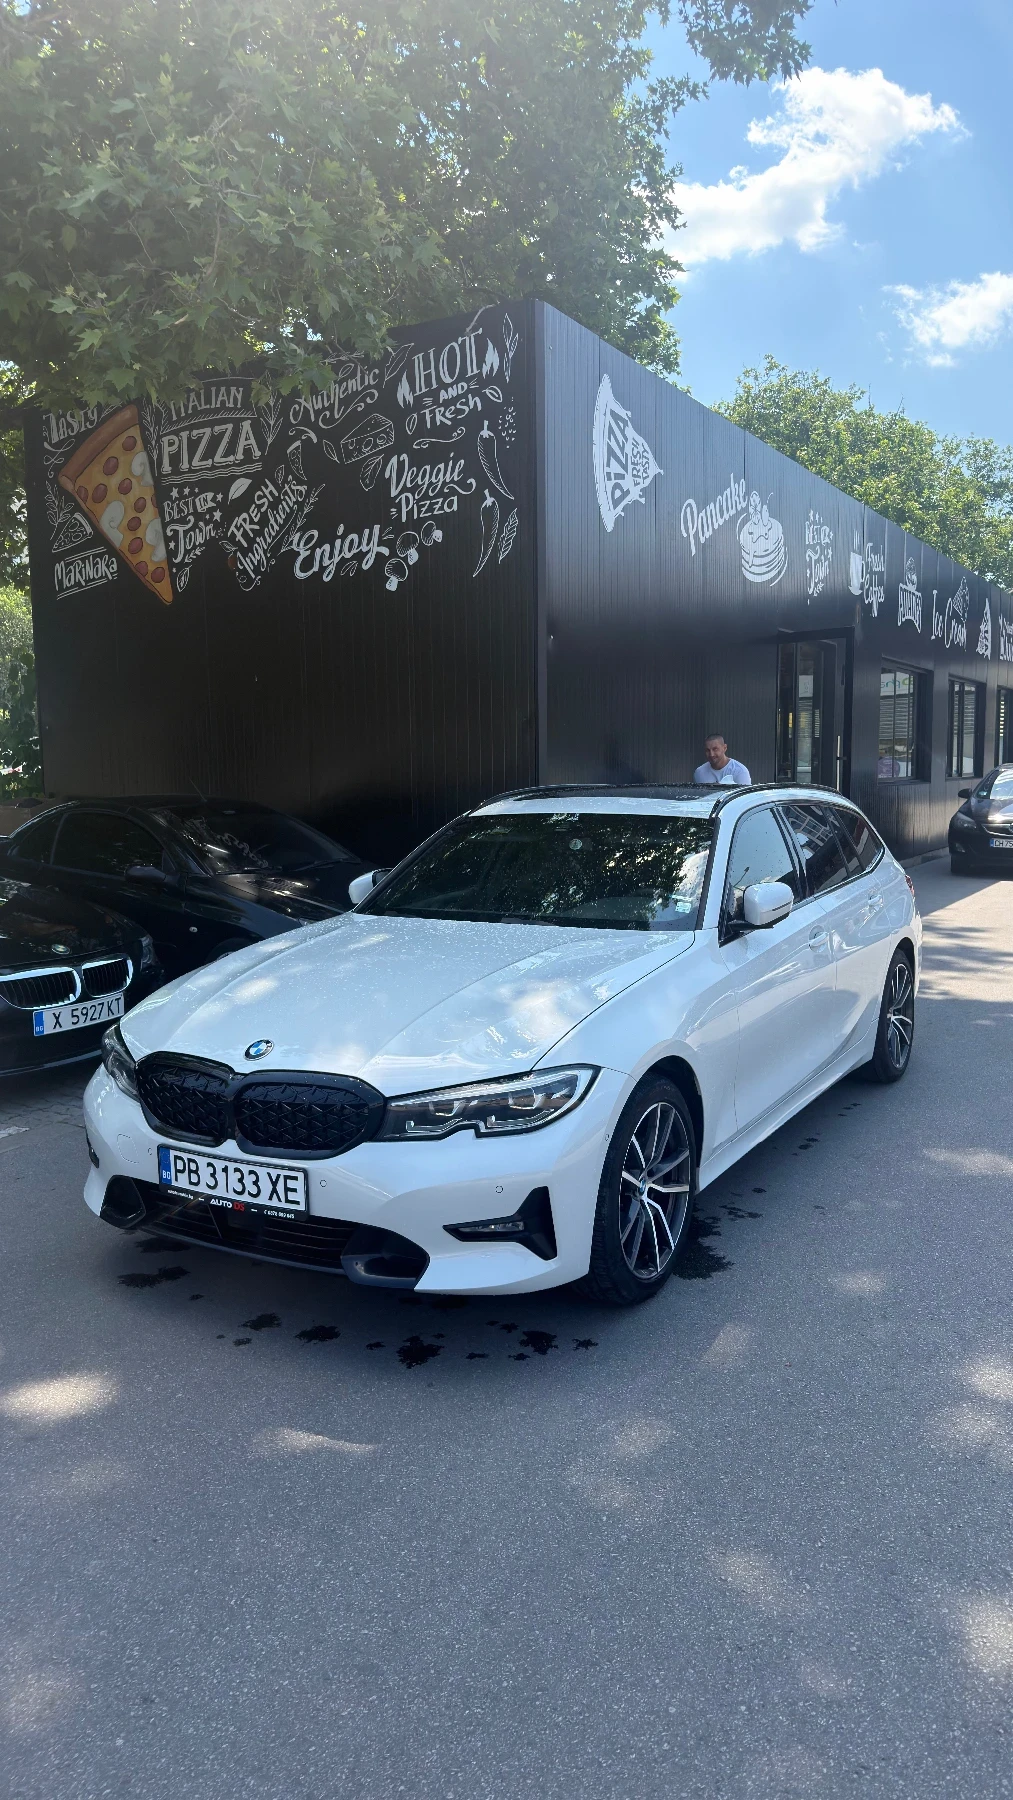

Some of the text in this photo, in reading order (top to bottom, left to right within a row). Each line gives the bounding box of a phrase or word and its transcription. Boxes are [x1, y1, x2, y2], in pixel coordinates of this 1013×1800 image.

[412, 328, 482, 397] HOT
[171, 386, 243, 421] ITALIAN
[290, 364, 379, 424] Authentic
[439, 382, 468, 403] AND
[160, 419, 262, 475] PIZZA
[641, 442, 650, 485] TASTY
[385, 452, 466, 498] Veggie
[163, 496, 194, 522] BEST
[228, 478, 278, 548] FRESH
[237, 475, 307, 579] Ingredients
[395, 492, 459, 522] Pizza
[681, 472, 747, 557] Pancake
[166, 515, 216, 564] Town
[292, 524, 389, 582] Enjoy
[930, 590, 943, 640] Ice
[944, 597, 967, 652] Cream
[52, 997, 122, 1030] X 5927 KT
[173, 1154, 301, 1206] PB 3133 XE
[209, 1198, 246, 1212] AUTO DS
